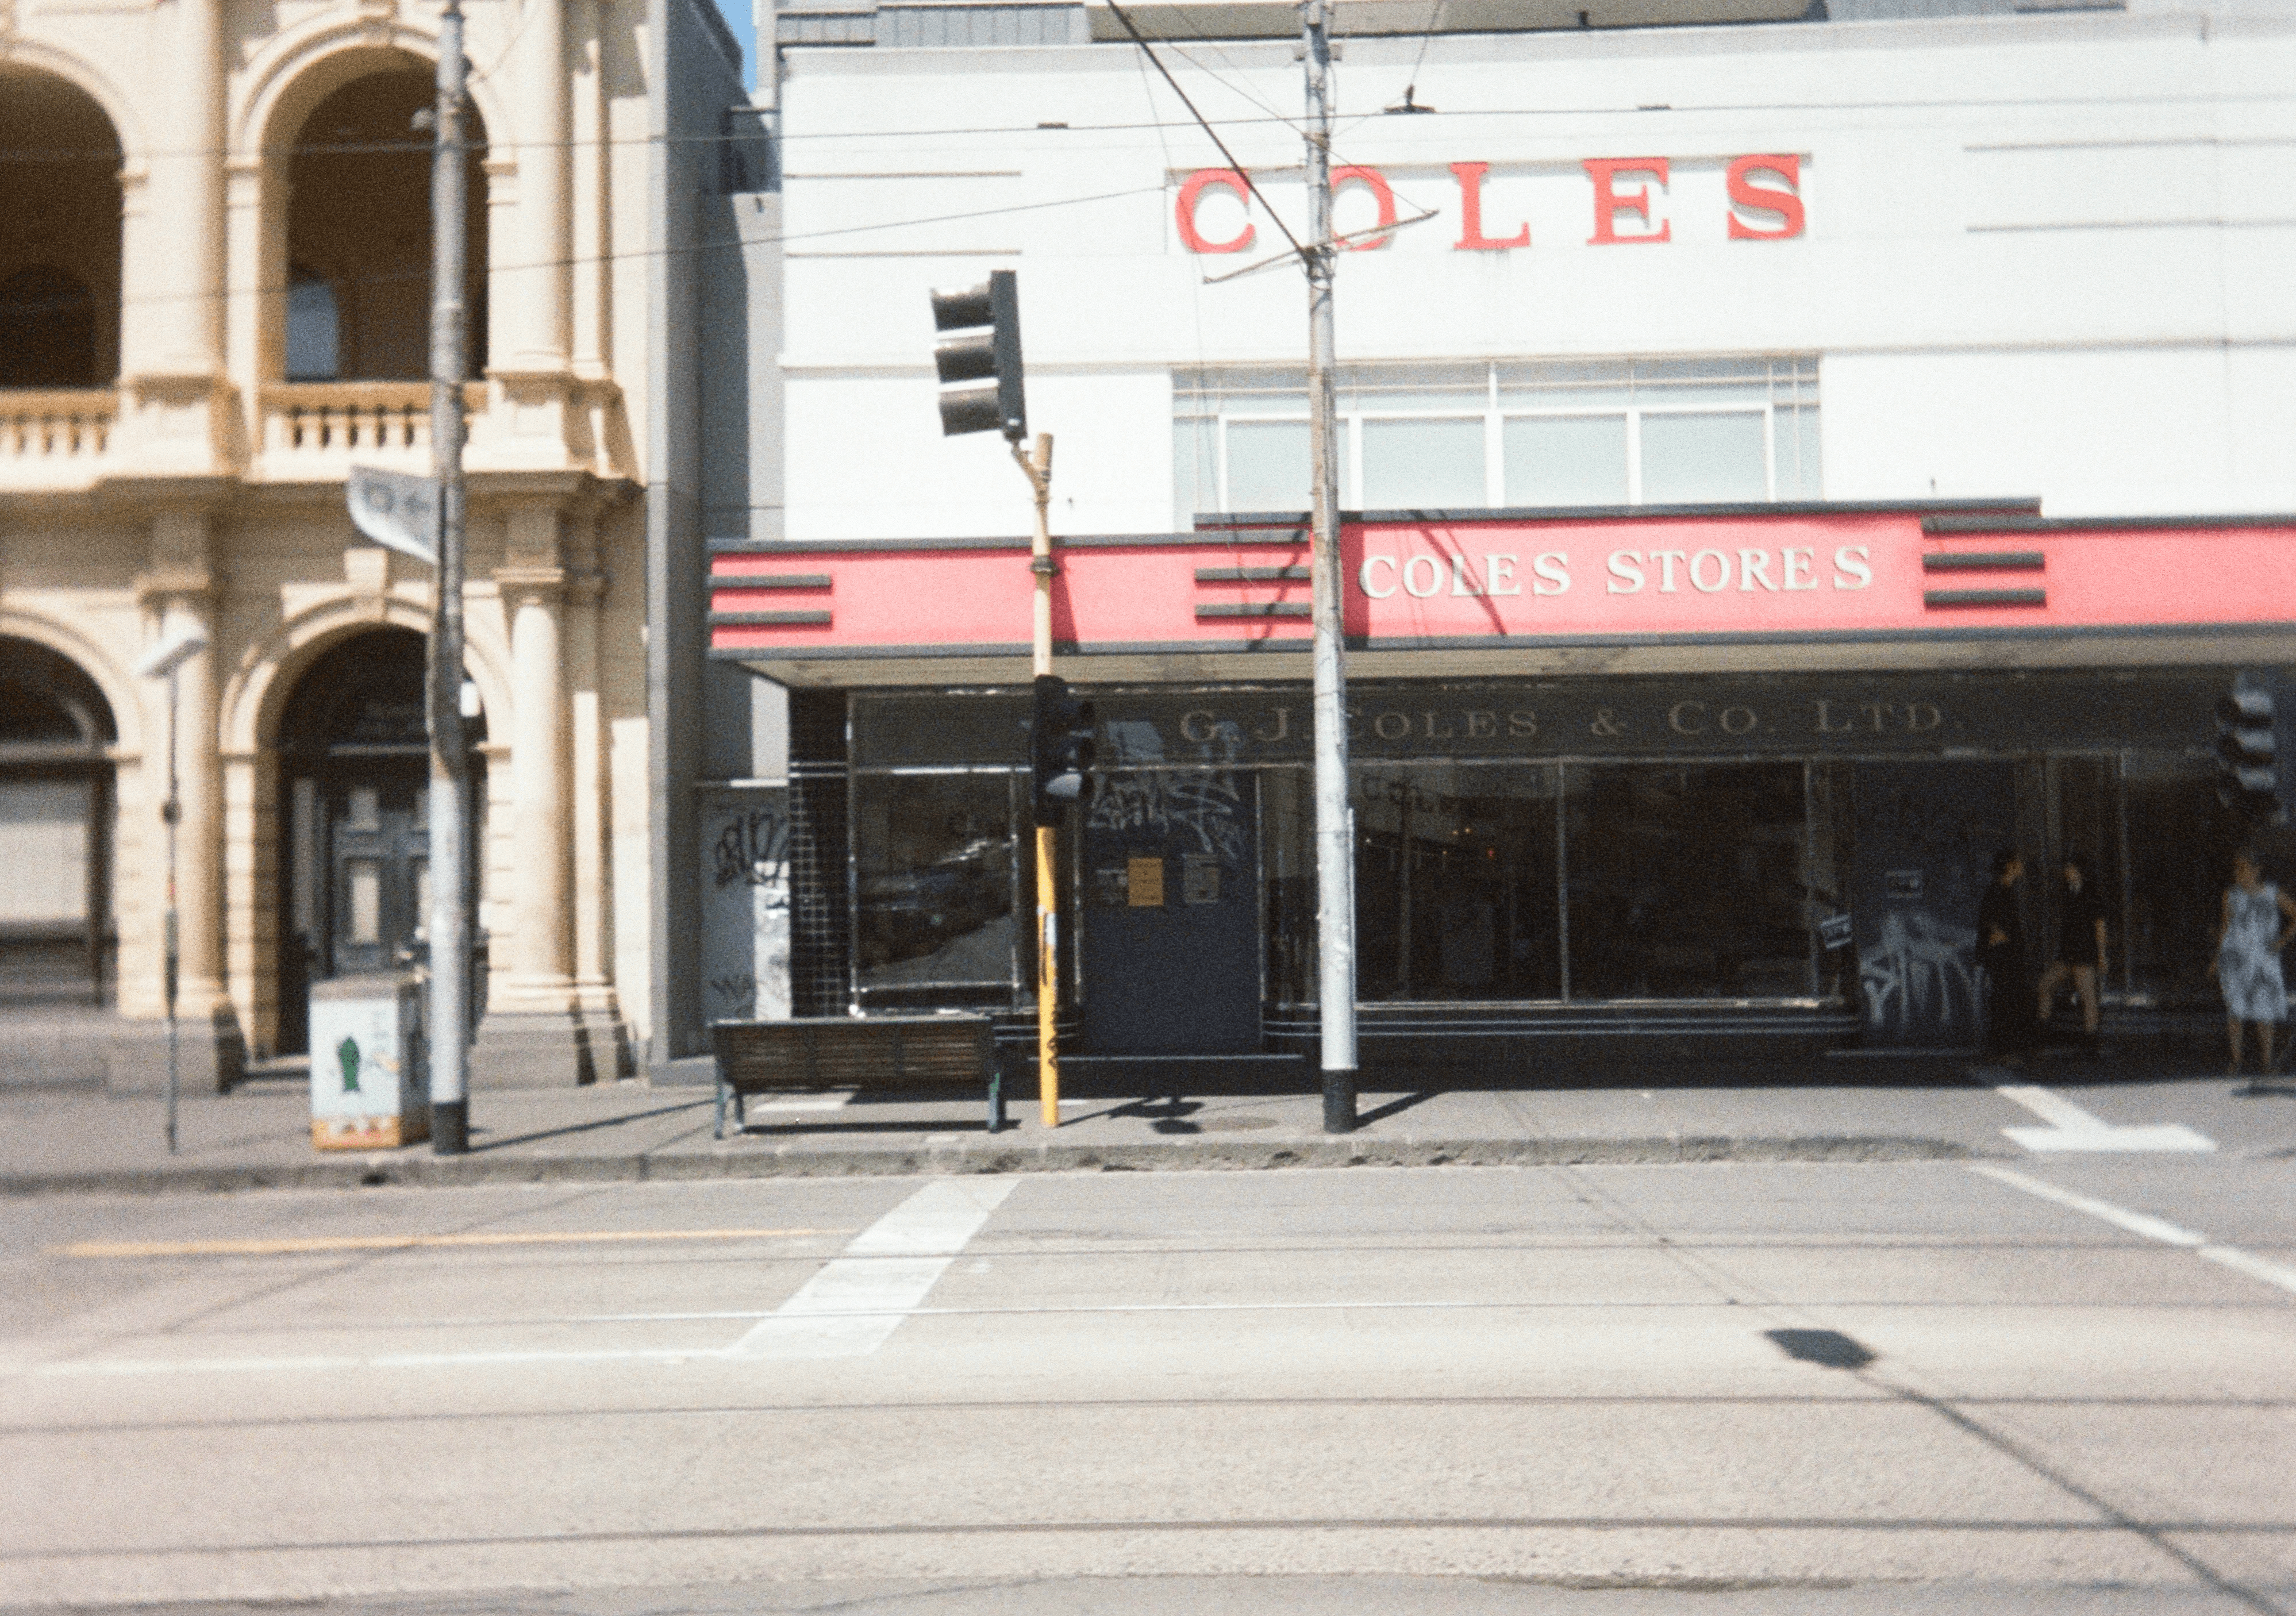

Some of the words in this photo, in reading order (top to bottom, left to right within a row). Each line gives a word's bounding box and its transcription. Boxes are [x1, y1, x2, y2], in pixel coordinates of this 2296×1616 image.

[1175, 153, 1807, 254] COLES
[1359, 552, 1571, 599] COLES
[1606, 545, 1873, 595] STORES
[1591, 707, 1627, 736] &
